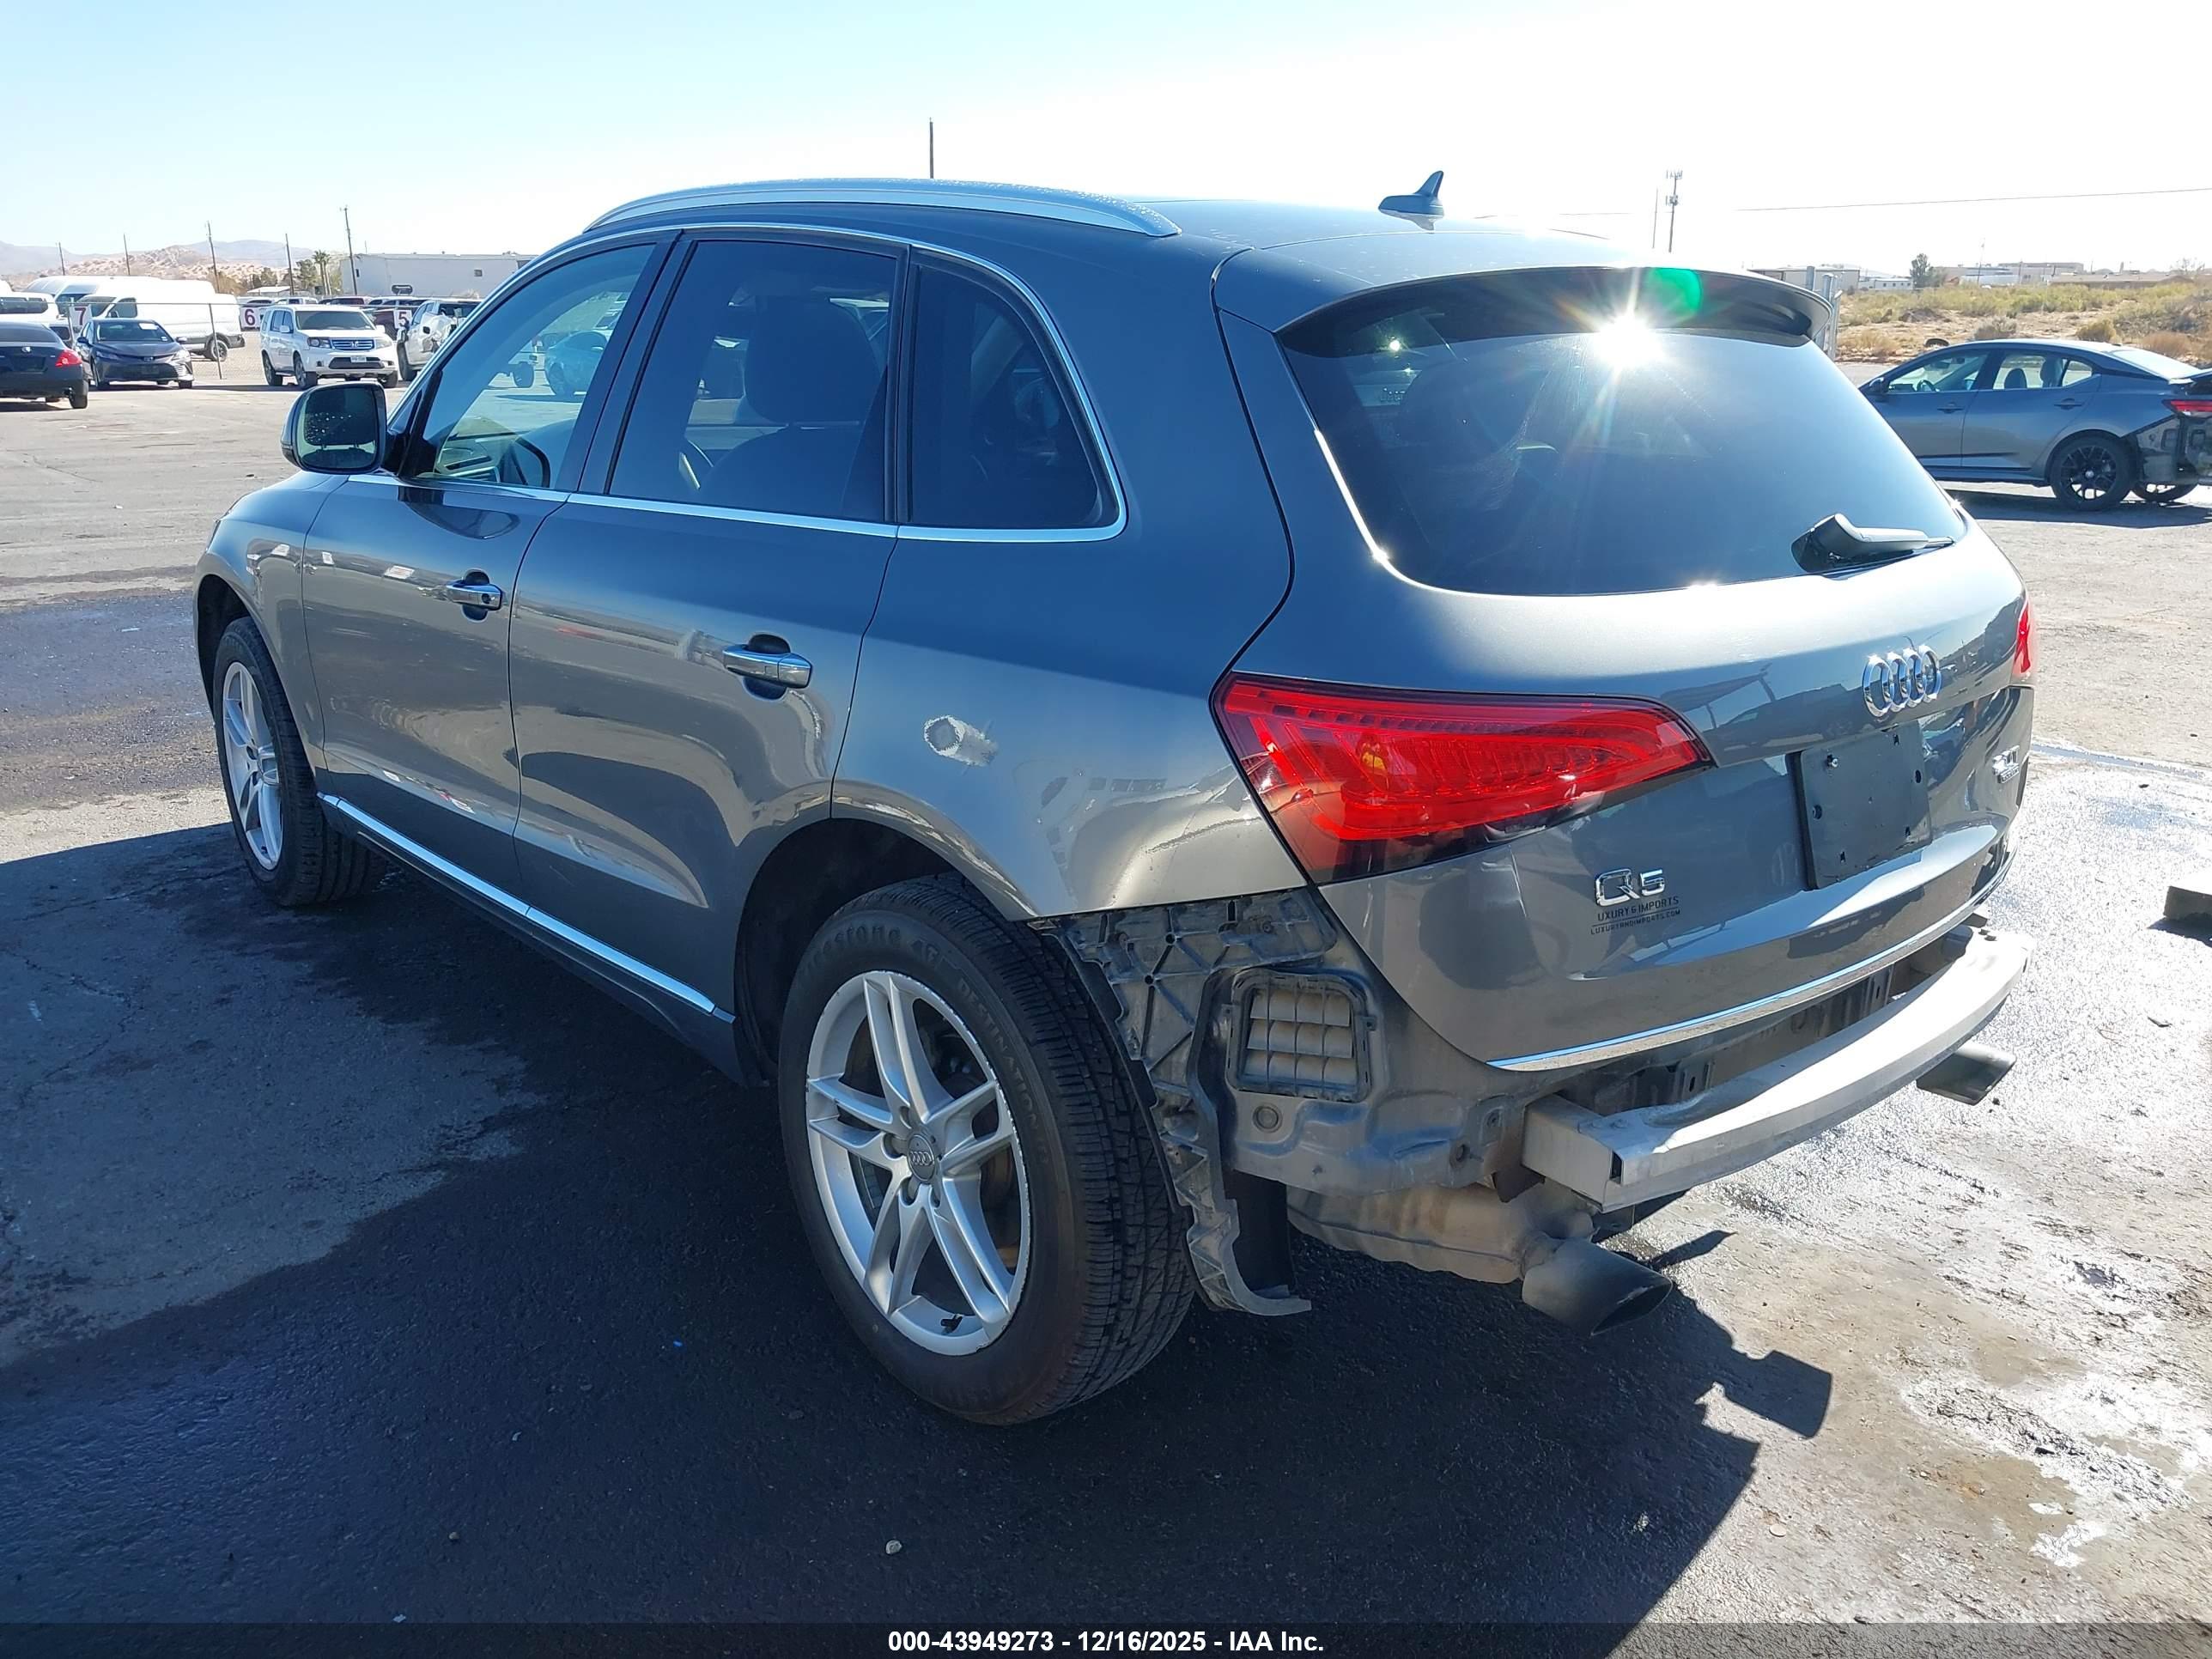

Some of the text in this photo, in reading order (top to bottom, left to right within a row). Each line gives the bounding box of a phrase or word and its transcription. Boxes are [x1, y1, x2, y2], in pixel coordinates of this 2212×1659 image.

[74, 307, 87, 325] 7
[244, 308, 256, 326] 6
[398, 311, 410, 327] 5
[1595, 868, 1666, 907] Q5
[1638, 896, 1680, 913] IMPORTS
[1590, 909, 1681, 935] LUXURYANDIMPORTS.COM
